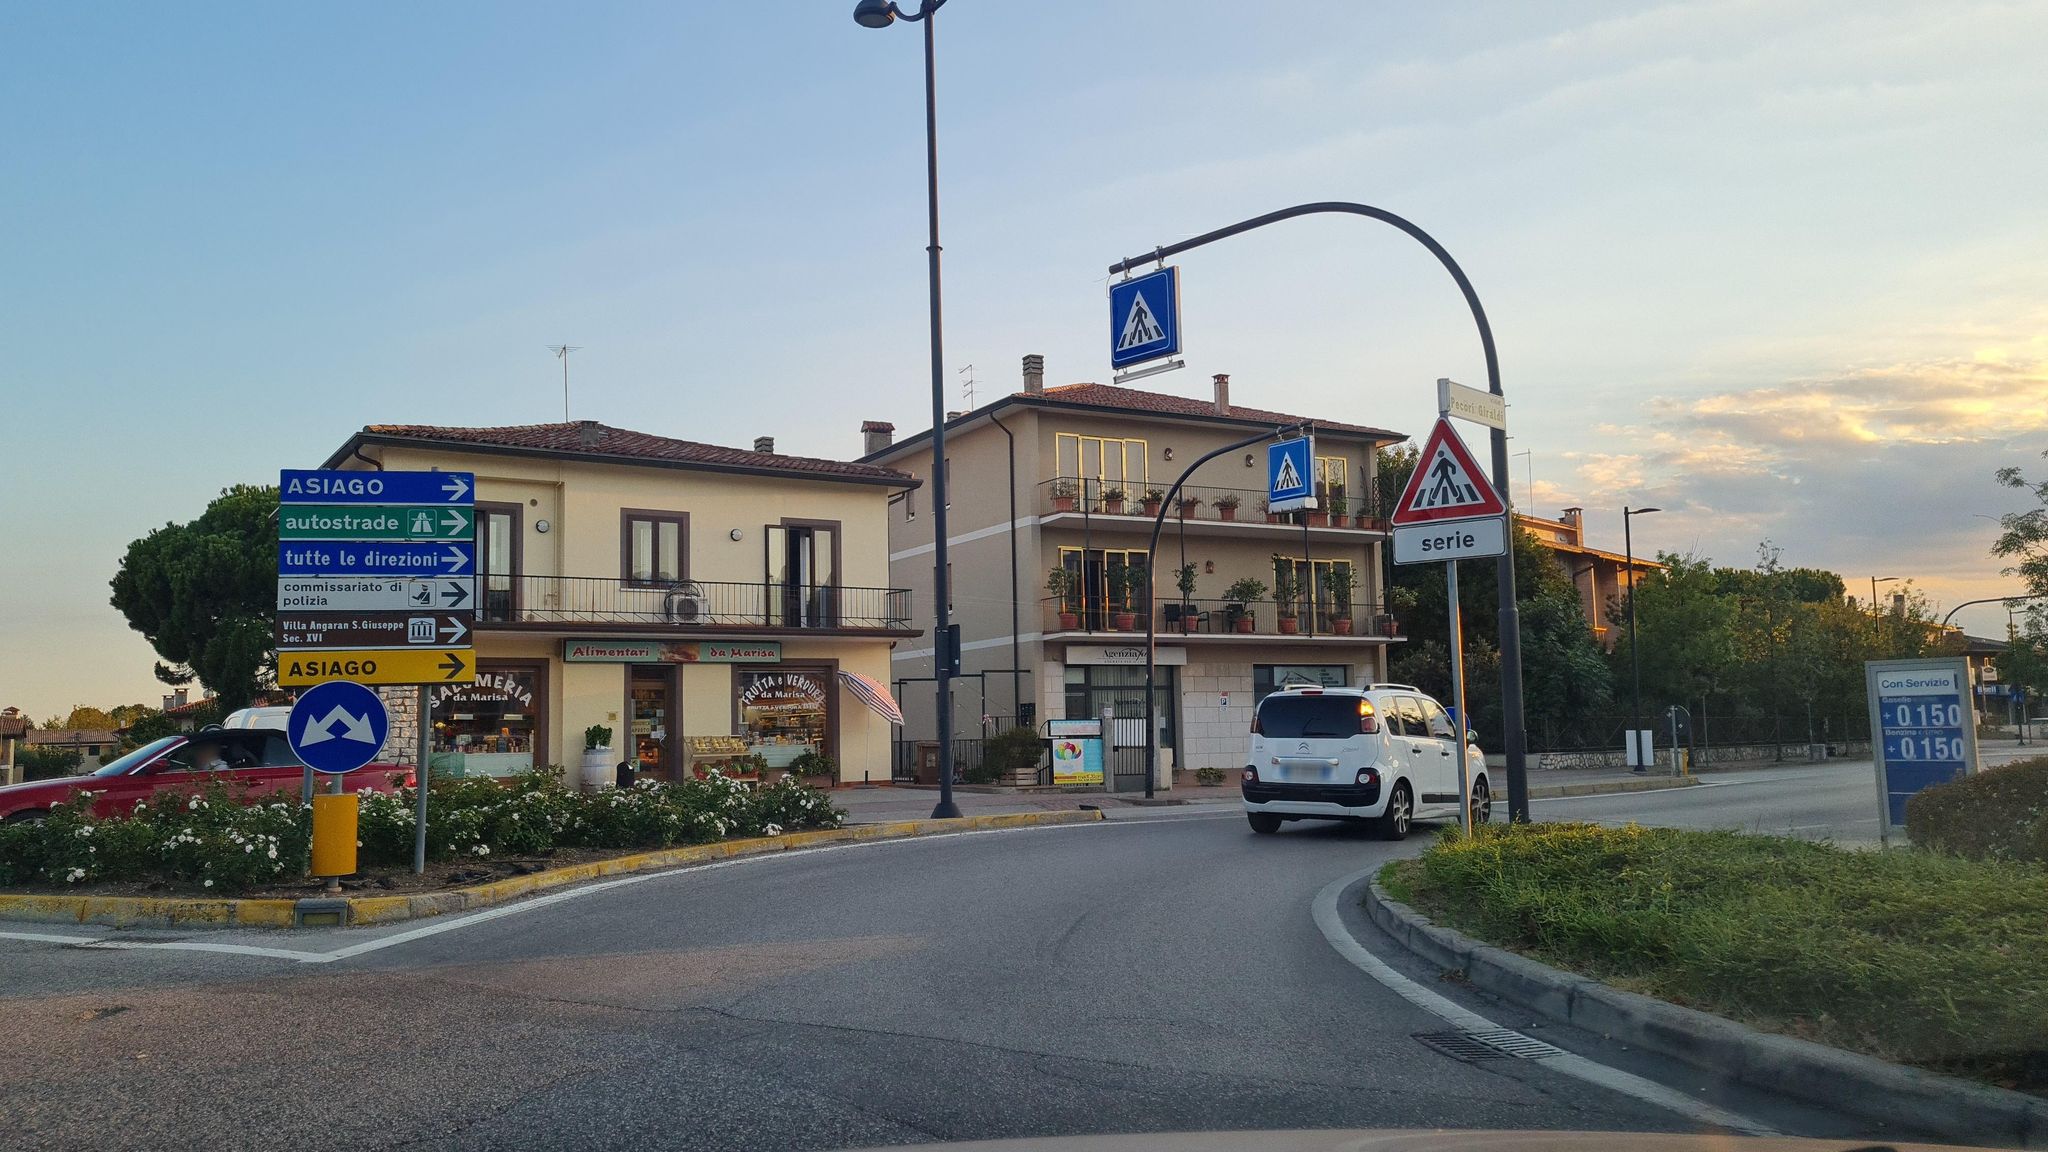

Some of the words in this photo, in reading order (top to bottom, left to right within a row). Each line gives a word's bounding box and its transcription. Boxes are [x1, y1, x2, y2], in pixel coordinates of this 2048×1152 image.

[287, 478, 384, 495] ASIAGO
[285, 514, 399, 531] autostrade
[1421, 531, 1475, 552] serie
[285, 550, 331, 566] tutte
[340, 550, 356, 566] le
[364, 551, 438, 567] direzioni
[283, 581, 383, 593] commissariato
[389, 581, 402, 592] di
[283, 595, 328, 607] polizia
[282, 620, 307, 631] Villa
[309, 621, 349, 632] Angaran
[282, 633, 303, 643] Sec.
[306, 633, 323, 643] XVI
[572, 646, 649, 658] Alimentari
[709, 646, 726, 658] da
[730, 647, 776, 659] Marisa
[1102, 648, 1138, 659] Agenzia
[288, 660, 377, 677] ASIAGO
[742, 675, 776, 706] FRUTTA
[777, 676, 783, 685] e
[786, 673, 826, 705] VERDURA
[1881, 679, 1904, 689] Con
[1905, 679, 1950, 688] Servizio
[452, 693, 467, 702] da
[470, 693, 509, 702] Marisa
[760, 690, 773, 699] da
[775, 690, 806, 699] Marisa
